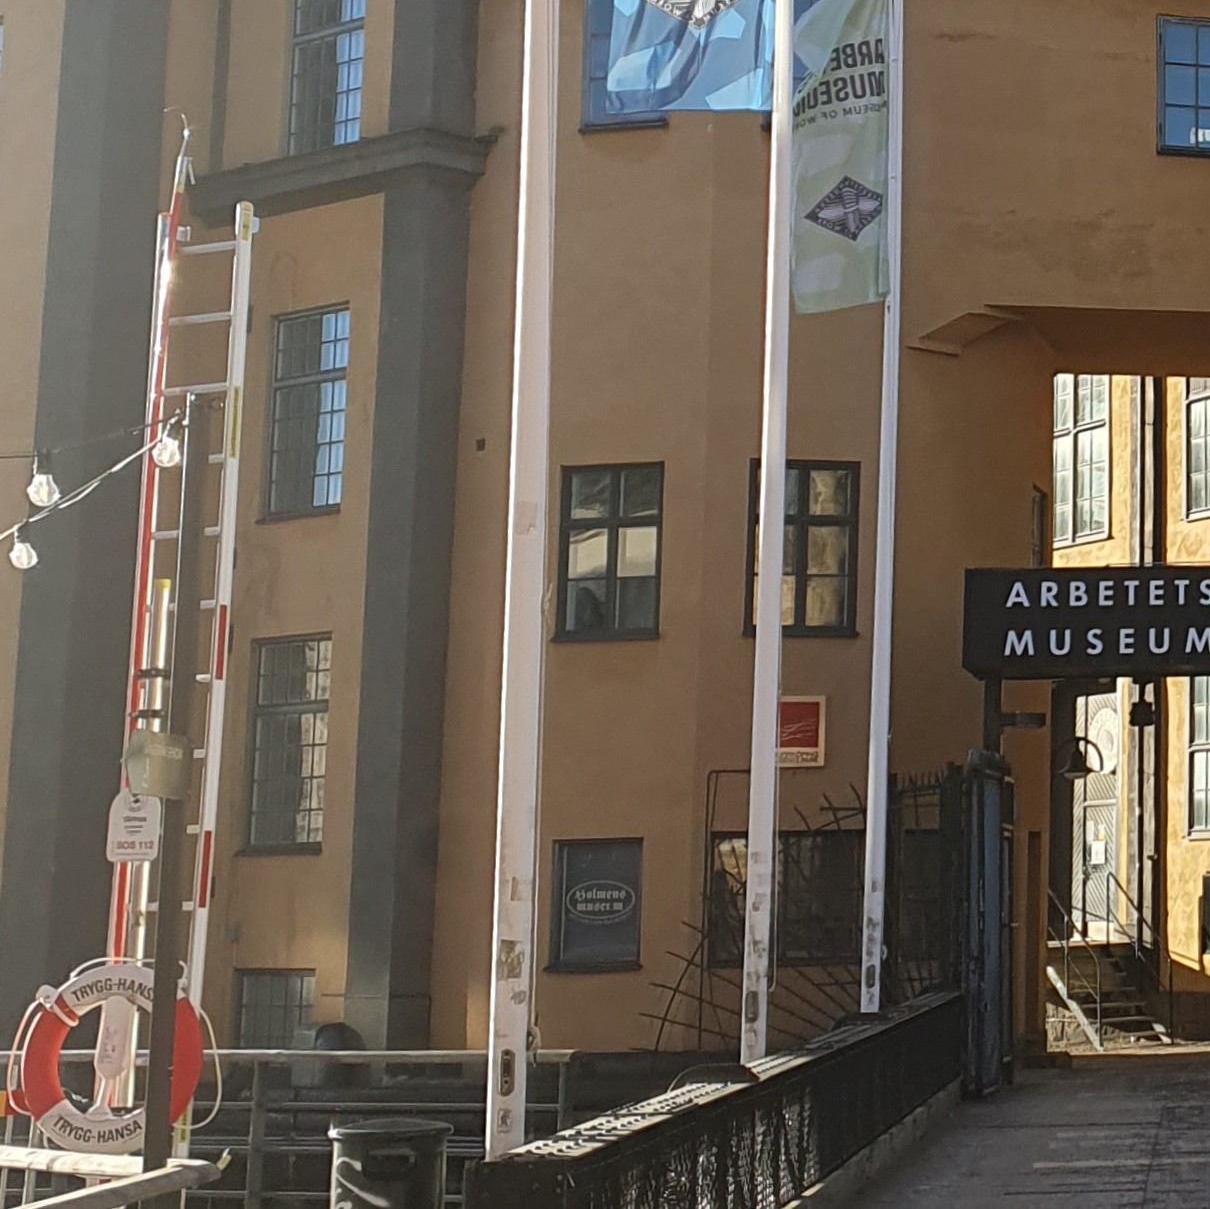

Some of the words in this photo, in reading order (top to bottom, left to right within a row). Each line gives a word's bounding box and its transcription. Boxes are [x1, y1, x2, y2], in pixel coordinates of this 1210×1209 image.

[116, 840, 136, 850] SOS
[138, 840, 154, 850] 112
[52, 1115, 143, 1144] TRYGG-HANSA
